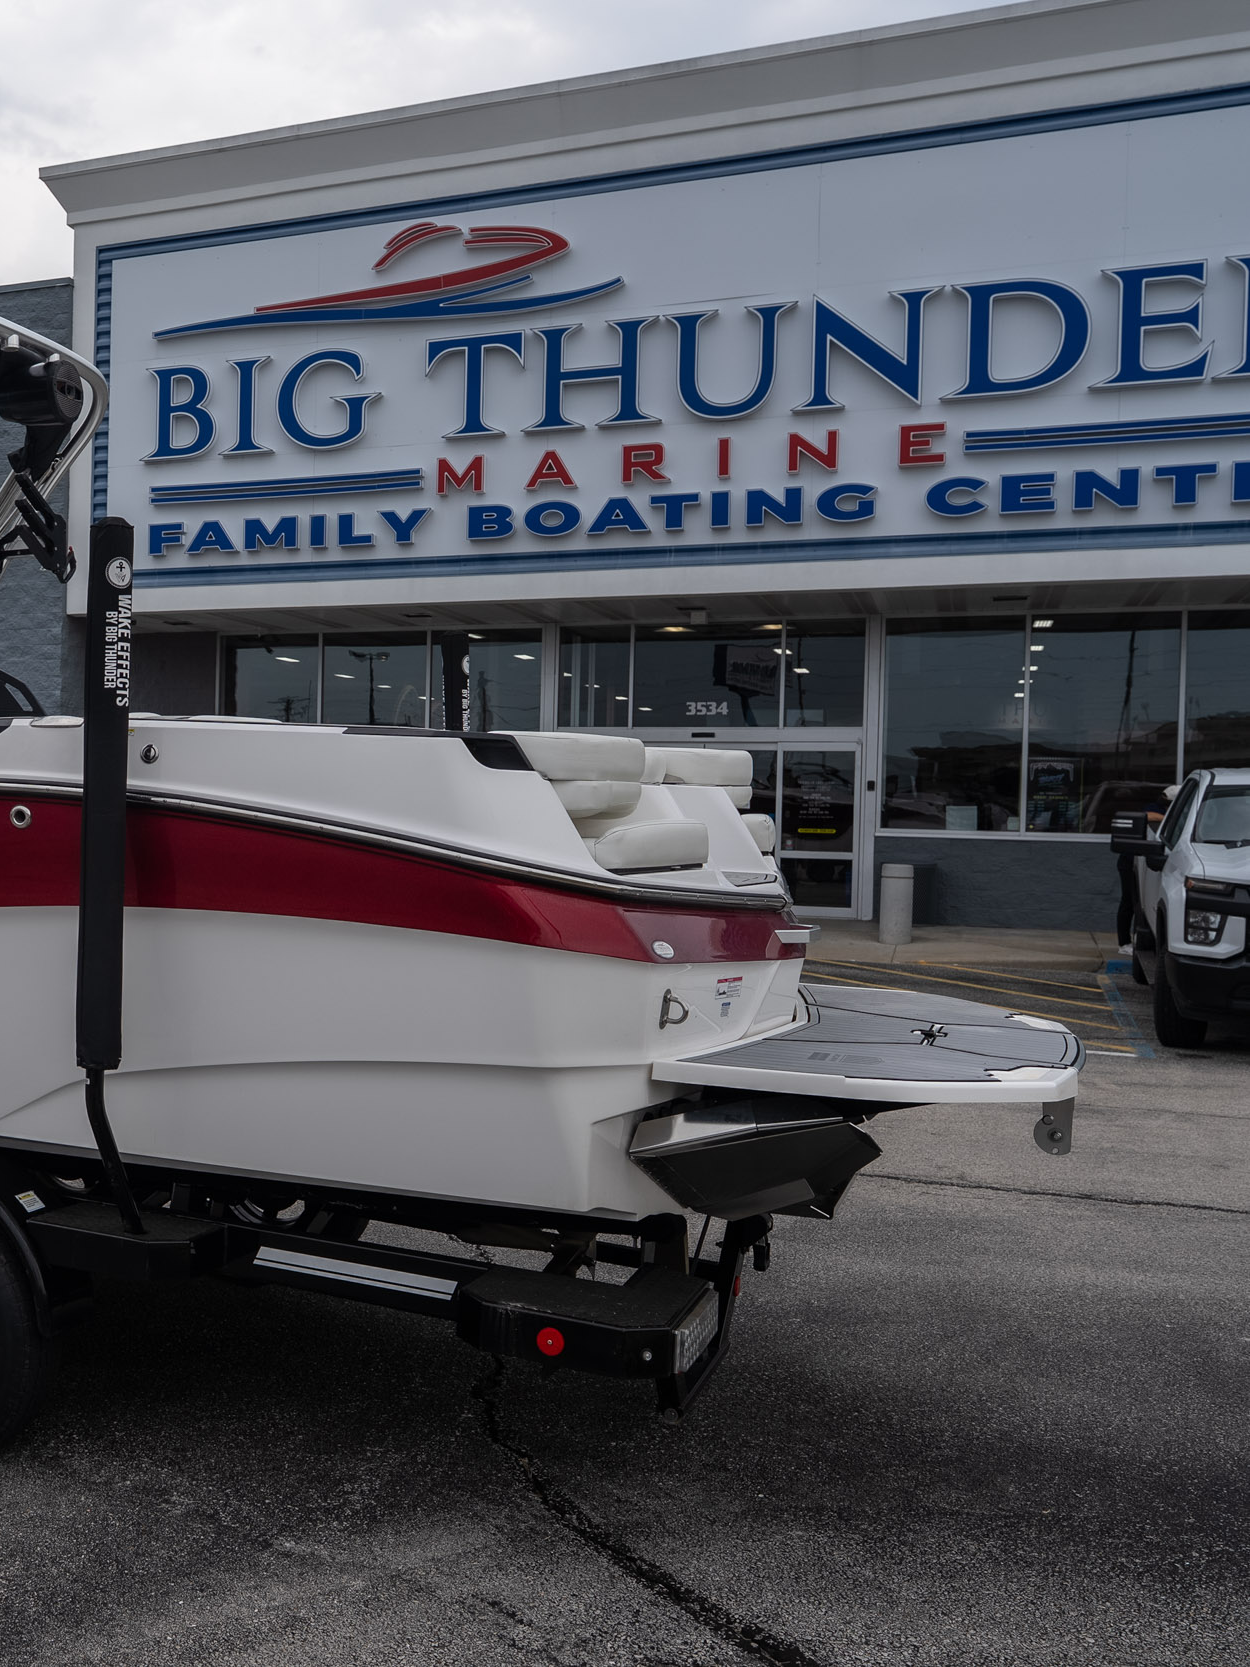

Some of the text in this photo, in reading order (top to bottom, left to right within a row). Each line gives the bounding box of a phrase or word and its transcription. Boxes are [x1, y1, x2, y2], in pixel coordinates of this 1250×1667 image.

[139, 254, 1250, 462] BIG THUNDE
[436, 422, 948, 496] MARINE
[148, 507, 433, 556] FAMILY
[466, 483, 879, 541] BOATING
[104, 611, 118, 689] BY BIG THUNDER
[116, 594, 132, 707] WAKE EFFECTS
[686, 702, 728, 715] 3534
